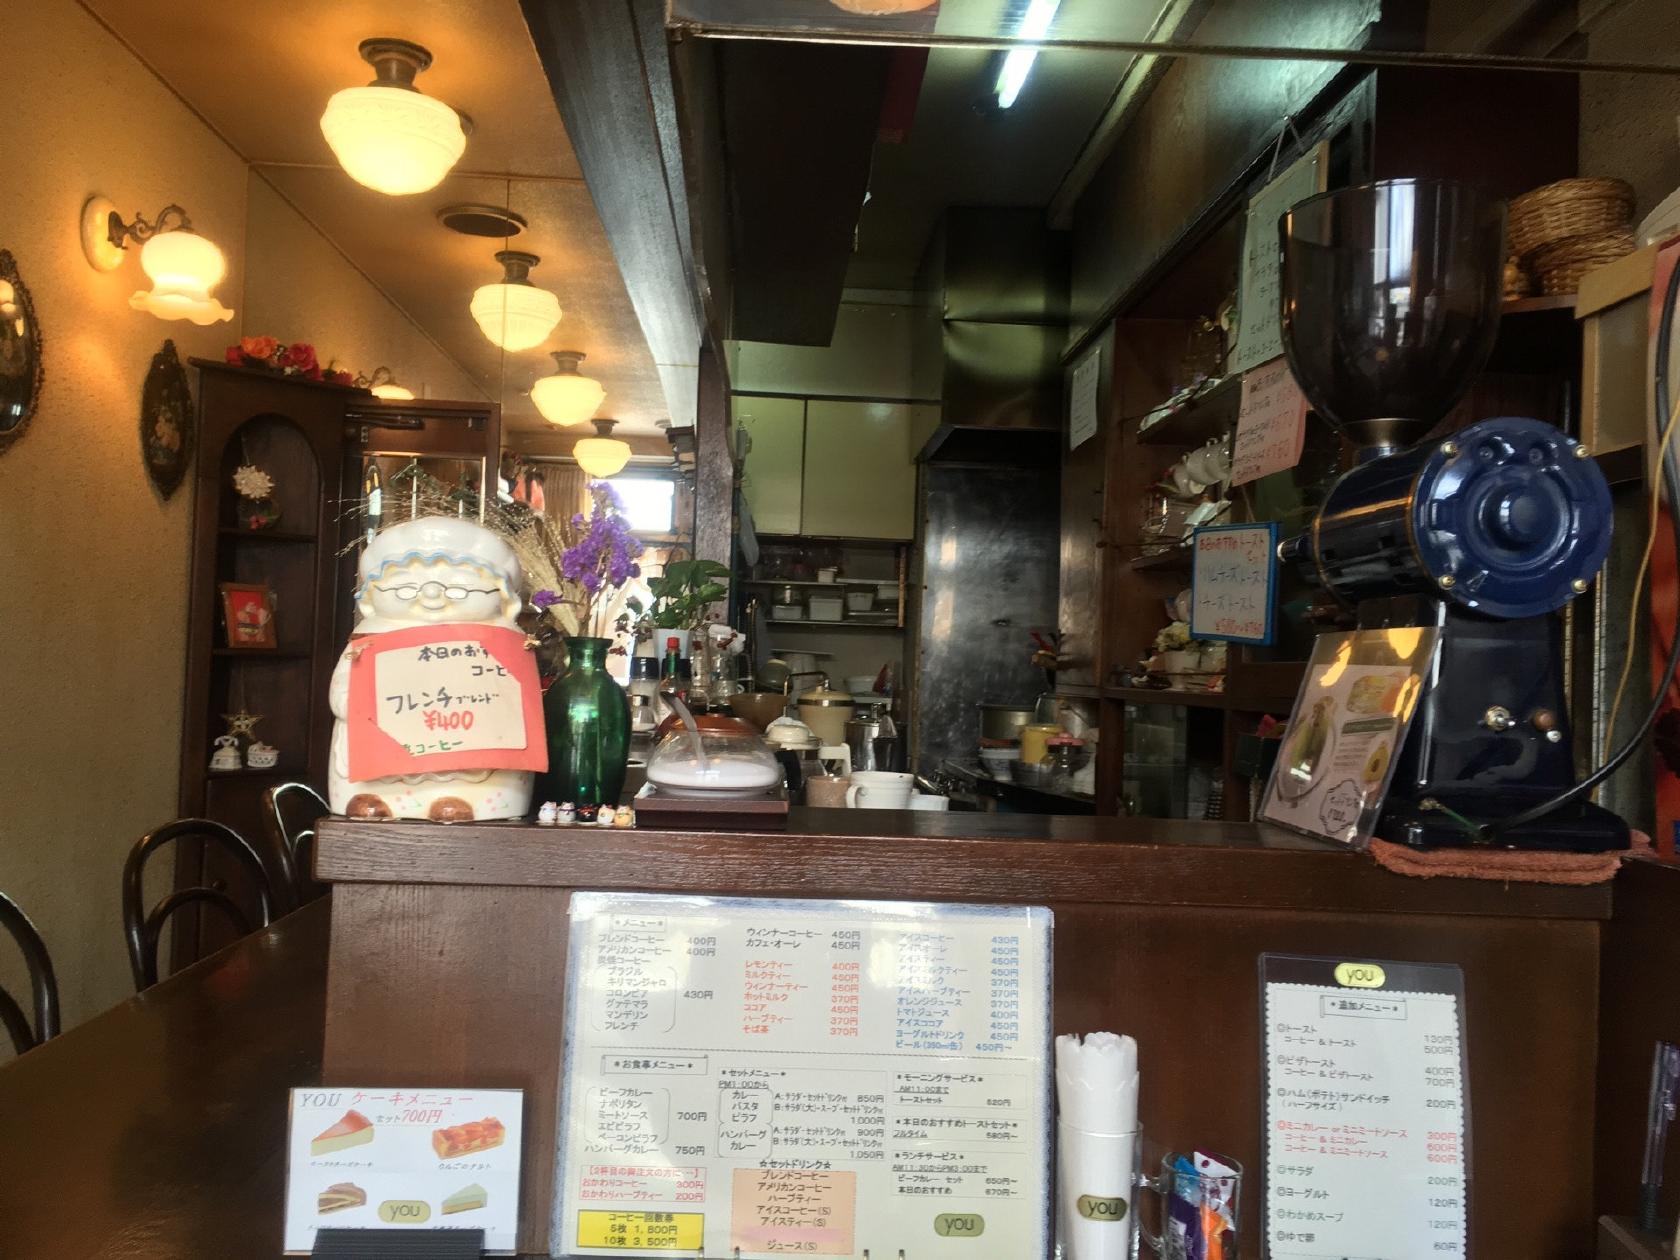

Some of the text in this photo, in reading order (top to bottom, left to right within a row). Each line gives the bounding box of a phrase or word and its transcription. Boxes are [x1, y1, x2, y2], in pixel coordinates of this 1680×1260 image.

[423, 711, 474, 730] ¥400
[746, 927, 861, 941] ウィンナーコーヒー 450円
[600, 934, 717, 947] ブレンドコーヒー 400円
[831, 941, 861, 950] 450円
[598, 945, 717, 958] アメリカンコーヒー 400円
[991, 946, 1019, 956] 450円
[745, 960, 860, 971] レモンティー 400円
[990, 957, 1019, 966] 450円
[744, 971, 860, 982] ミルクティー 450円
[990, 968, 1019, 978] 450円
[607, 977, 667, 987] キリマンジャロ
[744, 982, 860, 993] ウィンナーティー 450円
[990, 978, 1019, 988] 370円
[606, 989, 713, 1000] コロンビア 430円
[743, 992, 860, 1004] ホットミルク 370円
[990, 989, 1019, 998] 370円
[743, 1003, 859, 1015] ココア 450円
[897, 997, 1019, 1010] オレンジジュース 370円
[1338, 1000, 1391, 1012] 追加メニュー
[606, 1010, 649, 1021] マンデリン
[743, 1013, 859, 1026] ハーブティー 370円
[897, 1008, 1019, 1020] トマトジュース 400円
[604, 1021, 639, 1031] フレンチ
[896, 1018, 1019, 1031] アイスココア 450円
[1286, 1024, 1318, 1034] トースト
[742, 1024, 858, 1037] そば茶 370円
[895, 1029, 1019, 1042] ヨーグルトドリンク 450円
[1284, 1035, 1315, 1045] コーヒー
[1328, 1038, 1358, 1047] トースト
[1423, 1045, 1454, 1056] 500円
[622, 1060, 686, 1070] お食事メニュー
[729, 1069, 779, 1078] セットメニュー
[1284, 1067, 1316, 1078] コーヒー
[1424, 1066, 1455, 1077] 400円
[903, 1074, 977, 1083] モーニングサービス
[1425, 1077, 1456, 1088] 700円
[599, 1088, 654, 1097] ビーフカレー
[732, 1090, 758, 1100] カレー
[300, 1091, 474, 1108] YOU ケーキメニュー
[599, 1100, 642, 1109] ナポリタン
[857, 1094, 885, 1104] 850円
[900, 1095, 943, 1104] トーストセット
[1426, 1099, 1457, 1110] 200円
[732, 1102, 759, 1111] パスタ
[598, 1111, 707, 1122] ミートソース 700円
[731, 1113, 757, 1123] ピラフ
[598, 1122, 641, 1132] エビピラフ
[1286, 1122, 1329, 1133] ミニカレー
[1342, 1125, 1408, 1139] ミニミートソース
[1427, 1131, 1457, 1142] 300円
[720, 1129, 767, 1139] ハンバーグ
[857, 1128, 884, 1138] 900円
[598, 1134, 659, 1144] ベーコンピラフ
[1284, 1133, 1315, 1143] コーヒー
[1329, 1134, 1368, 1146] ミニカレー
[583, 1144, 705, 1156] ハンバーグカレー 750円
[730, 1141, 757, 1151] カレー
[1284, 1144, 1318, 1153] コーヒー
[1329, 1146, 1389, 1159] ミニミートソース
[901, 1152, 957, 1161] ランチサービス
[761, 1170, 829, 1181] ブレンドコーヒー
[1286, 1165, 1314, 1176] サラダ
[582, 1178, 704, 1189] おかわりコーヒー 300円
[898, 1174, 940, 1183] ビーフカレー
[1427, 1176, 1458, 1187] 200円
[757, 1182, 833, 1192] アメリカンコーヒー
[898, 1186, 953, 1195] 本日のおすすめ
[581, 1190, 704, 1201] おかわりハーブティー 200円
[767, 1194, 822, 1203] ハーブティー
[1286, 1187, 1330, 1200] ヨーグルト
[1427, 1198, 1458, 1209] 120円
[608, 1213, 674, 1223] コーヒー回数券
[1286, 1209, 1345, 1223] わかめスープ
[610, 1224, 627, 1234] 5枚
[1427, 1220, 1458, 1231] 120円
[603, 1236, 627, 1246] 10枚
[1433, 1242, 1458, 1252] 60円
